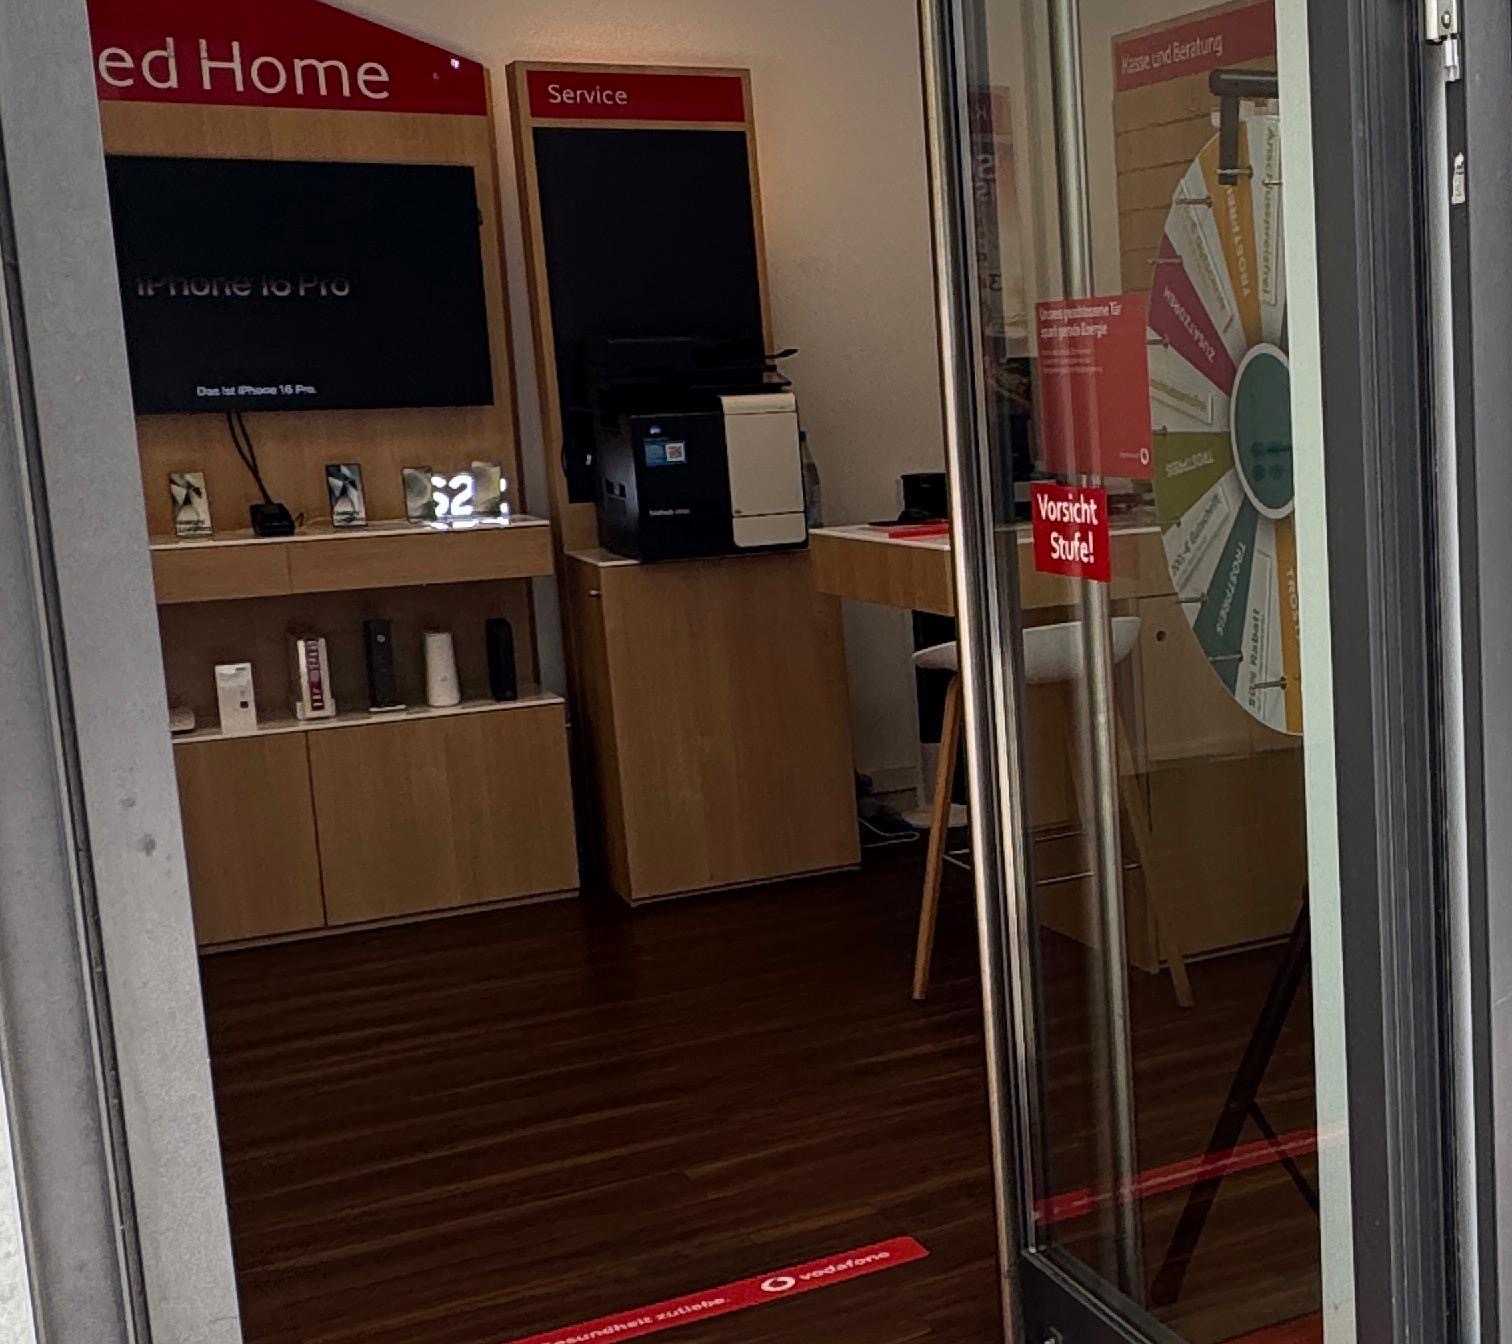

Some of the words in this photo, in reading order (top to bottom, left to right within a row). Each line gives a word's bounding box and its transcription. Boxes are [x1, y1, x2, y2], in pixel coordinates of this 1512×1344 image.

[98, 36, 179, 89] ed
[198, 37, 390, 100] Home
[1120, 54, 1151, 75] Kasse
[1151, 45, 1172, 68] und
[1172, 33, 1224, 63] Beratung
[547, 83, 628, 106] Service
[238, 385, 278, 397] iPhone
[1036, 492, 1099, 526] Vorsicht
[1050, 530, 1095, 564] Stufe!
[798, 1250, 891, 1282] vodafone
[655, 1295, 731, 1321] zuliebe.
